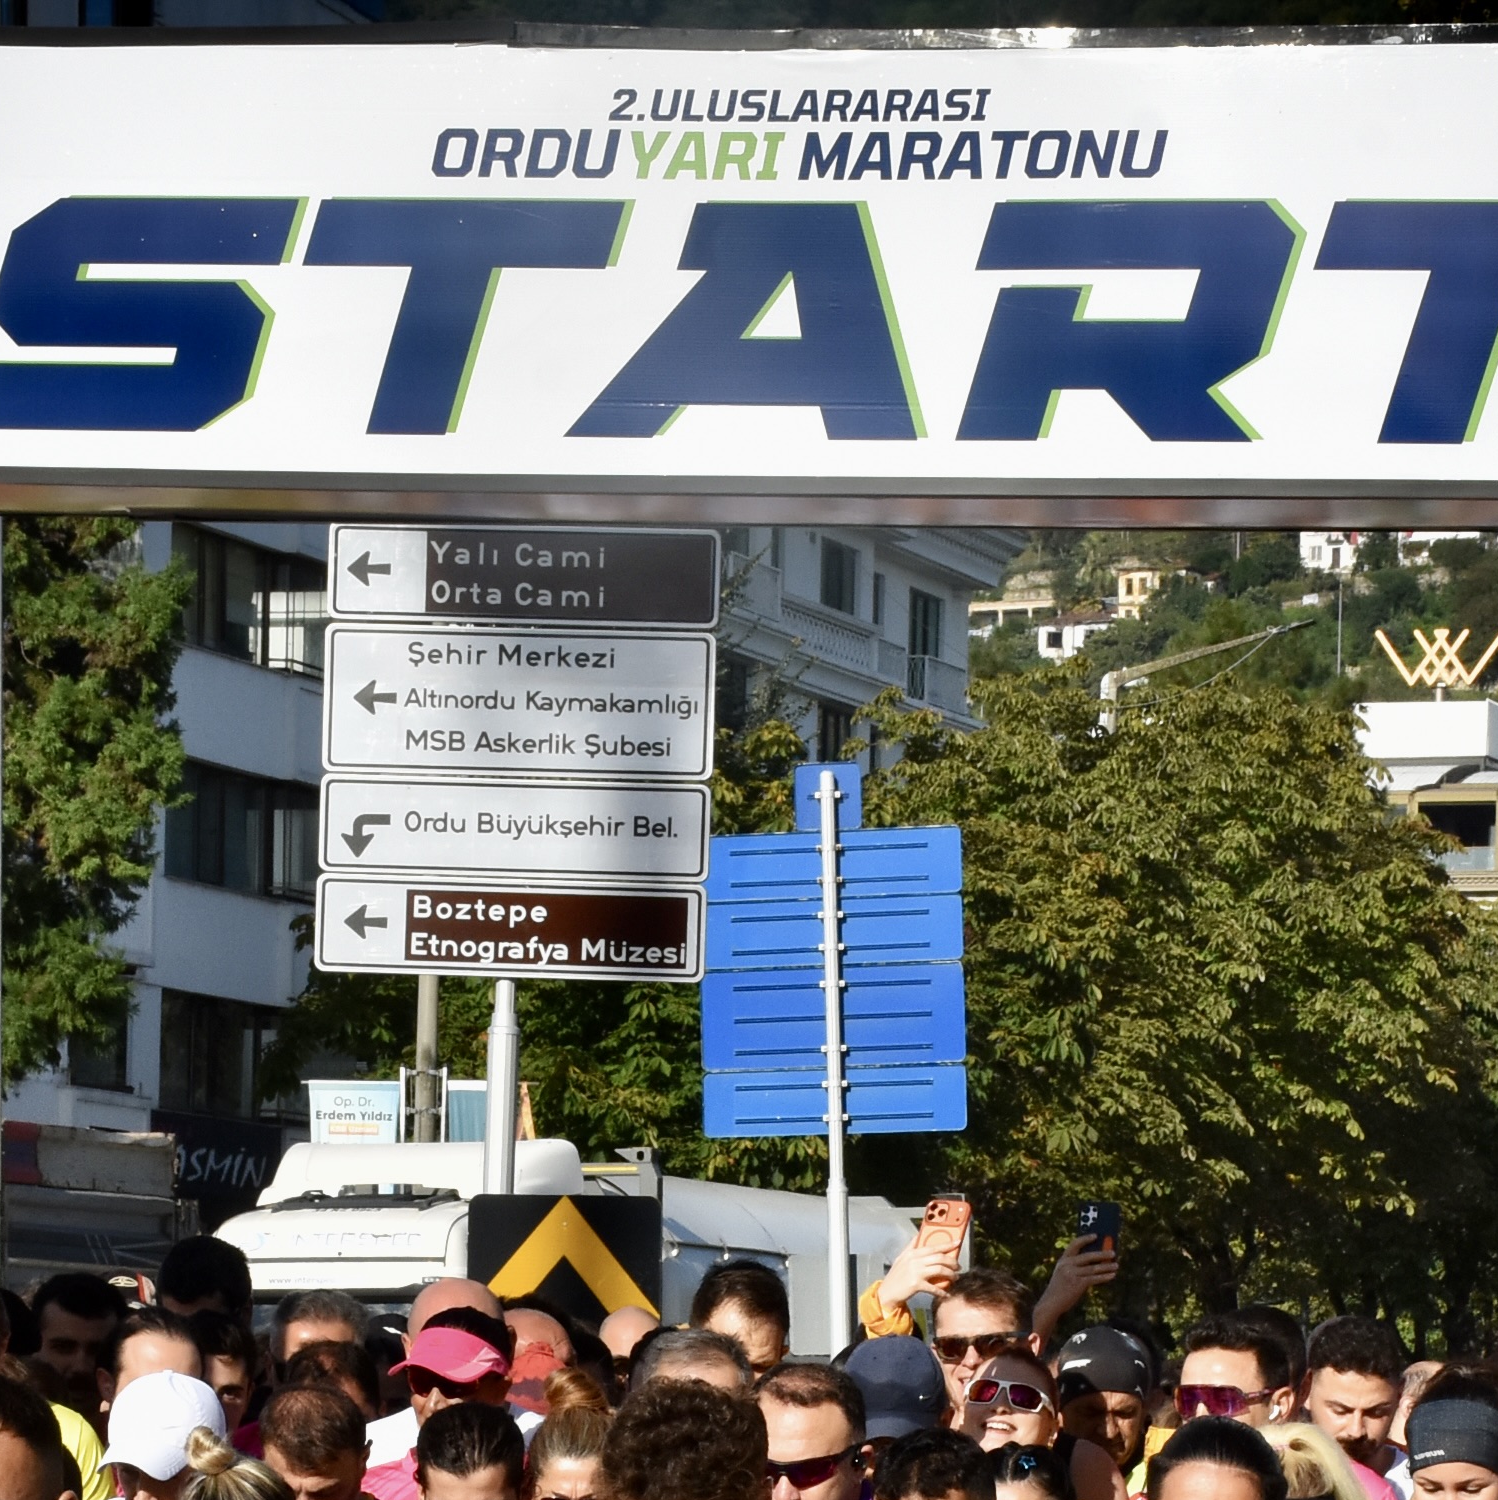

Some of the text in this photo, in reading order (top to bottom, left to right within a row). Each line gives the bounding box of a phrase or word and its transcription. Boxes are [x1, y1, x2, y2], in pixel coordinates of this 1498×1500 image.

[608, 88, 992, 123] 2.ULUSLARARASI
[795, 128, 1168, 182] MARATONU
[430, 541, 606, 568] Yalı Cami
[430, 581, 606, 608] Orta Cami
[406, 642, 616, 669] Şehir Merkezi
[403, 688, 699, 720] Altınordu Kaymakamlığı
[405, 730, 672, 760] MSB Askerlik Şubesi
[403, 811, 679, 840] Ordu Büyükşehir Bel.
[412, 896, 549, 929] Boztepe
[409, 932, 687, 966] Etnografya Müzesi
[315, 1110, 393, 1122] Erdem Yıldız
[334, 1096, 375, 1108] Op. Dr.
